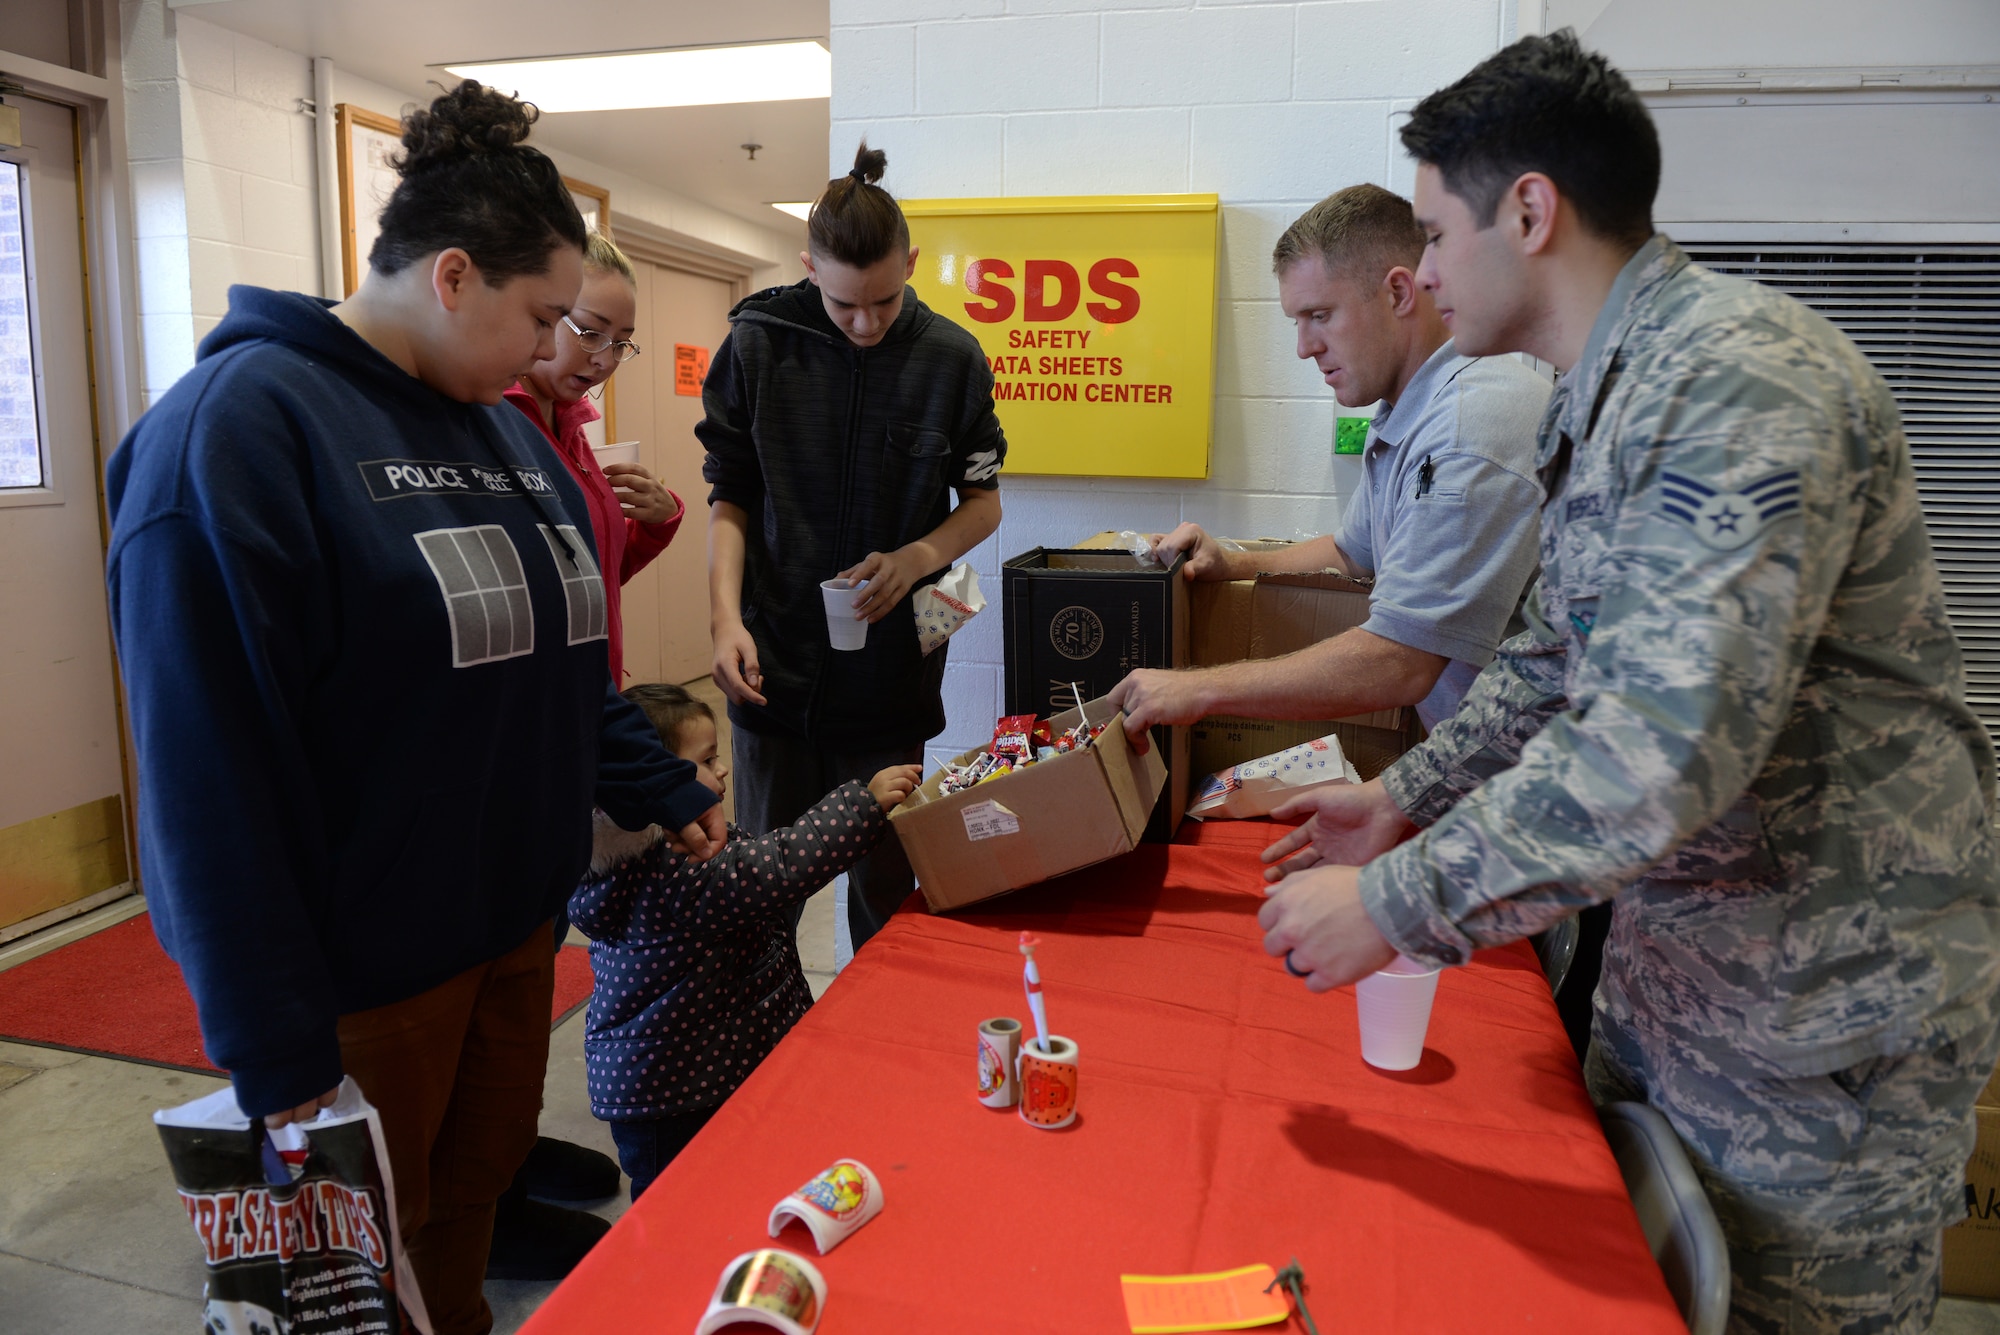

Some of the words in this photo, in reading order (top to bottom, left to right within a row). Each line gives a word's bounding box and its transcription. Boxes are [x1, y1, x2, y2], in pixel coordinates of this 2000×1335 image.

[963, 257, 1141, 324] SDS
[1008, 329, 1091, 349] SAFETY
[1038, 357, 1123, 376] SHEETS
[990, 382, 1077, 402] MATION
[1085, 383, 1173, 404] CENTER
[384, 465, 469, 490] POLICE
[483, 479, 513, 492] CALL
[516, 470, 552, 491] BOX
[1055, 611, 1074, 635] MEDALS
[1131, 600, 1140, 641] AWARDS
[1065, 622, 1080, 644] 70
[1056, 637, 1074, 654] GOLD
[1131, 642, 1140, 660] BUY
[1050, 679, 1086, 716] OX
[312, 1269, 335, 1284] with
[331, 1284, 342, 1293] or
[302, 1309, 330, 1321] Hide,
[329, 1304, 347, 1316] Get
